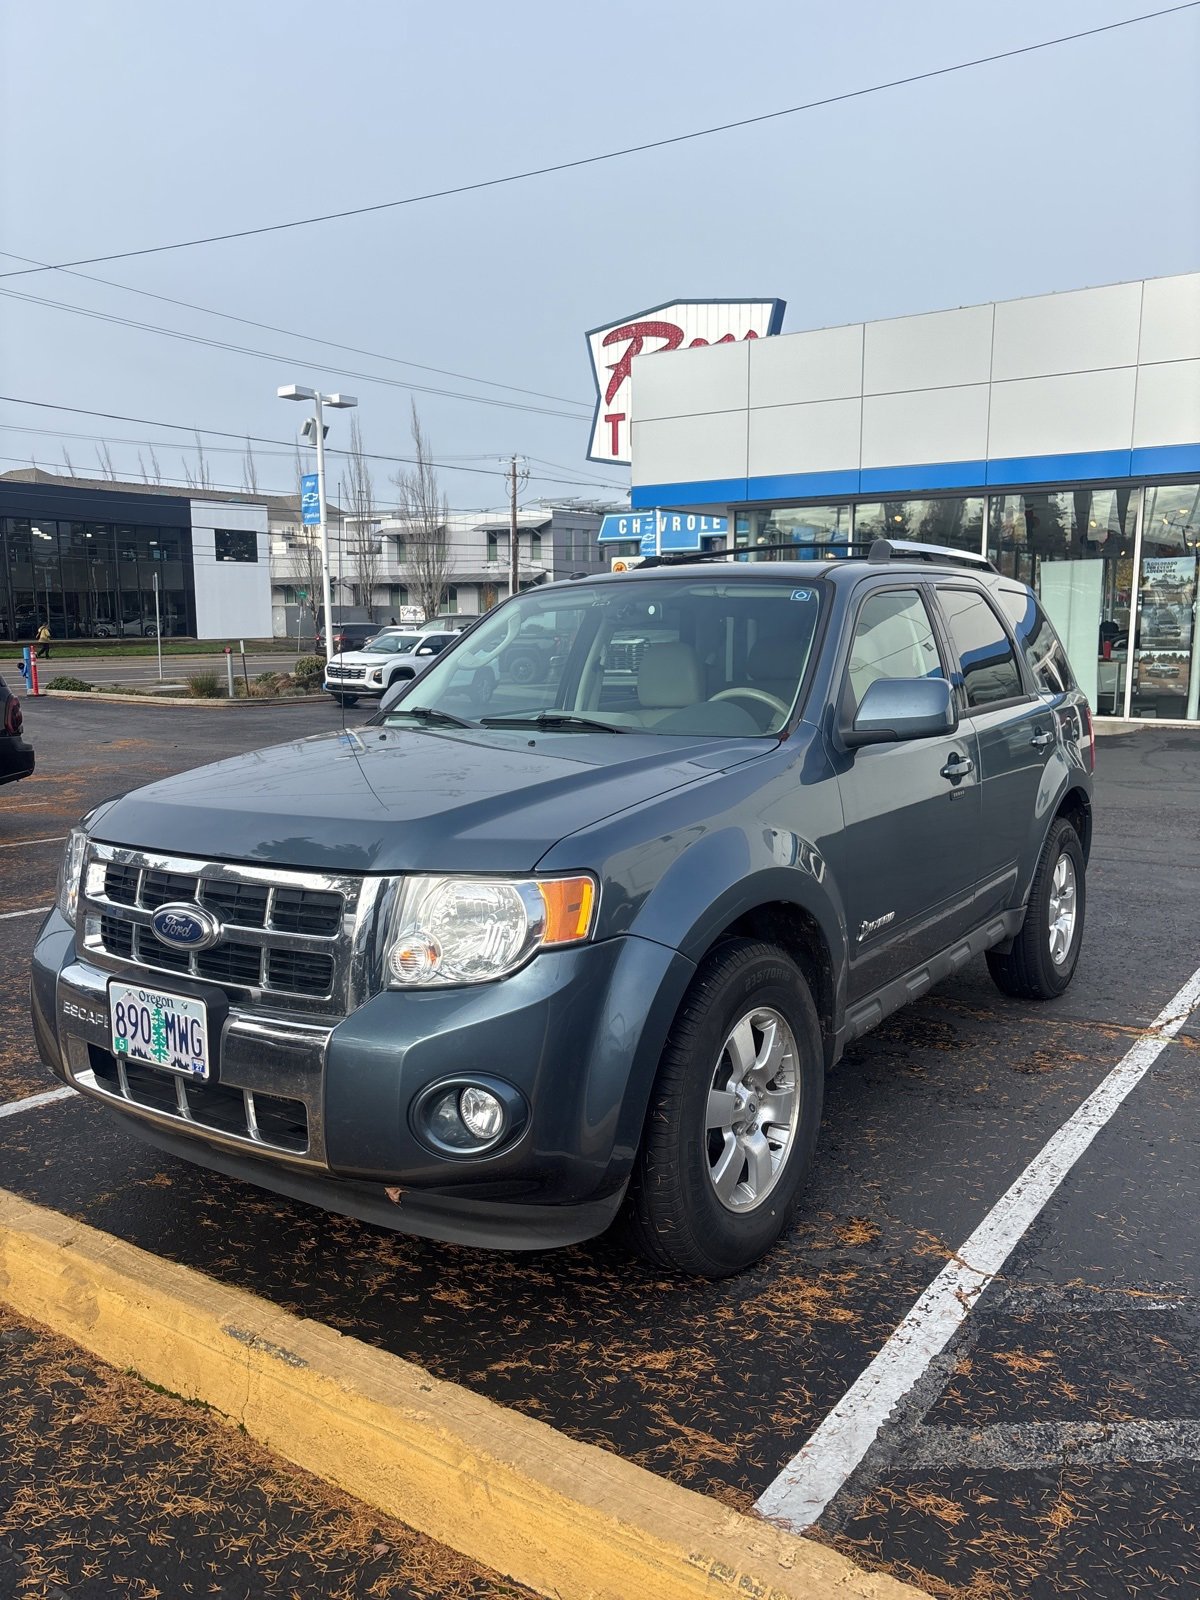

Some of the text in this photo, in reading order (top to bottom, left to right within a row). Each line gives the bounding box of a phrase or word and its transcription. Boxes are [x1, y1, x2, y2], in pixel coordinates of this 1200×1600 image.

[162, 914, 193, 937] Ford
[138, 990, 175, 1009] Oregon
[115, 1001, 202, 1057] 890 MWG
[119, 1040, 125, 1049] 5
